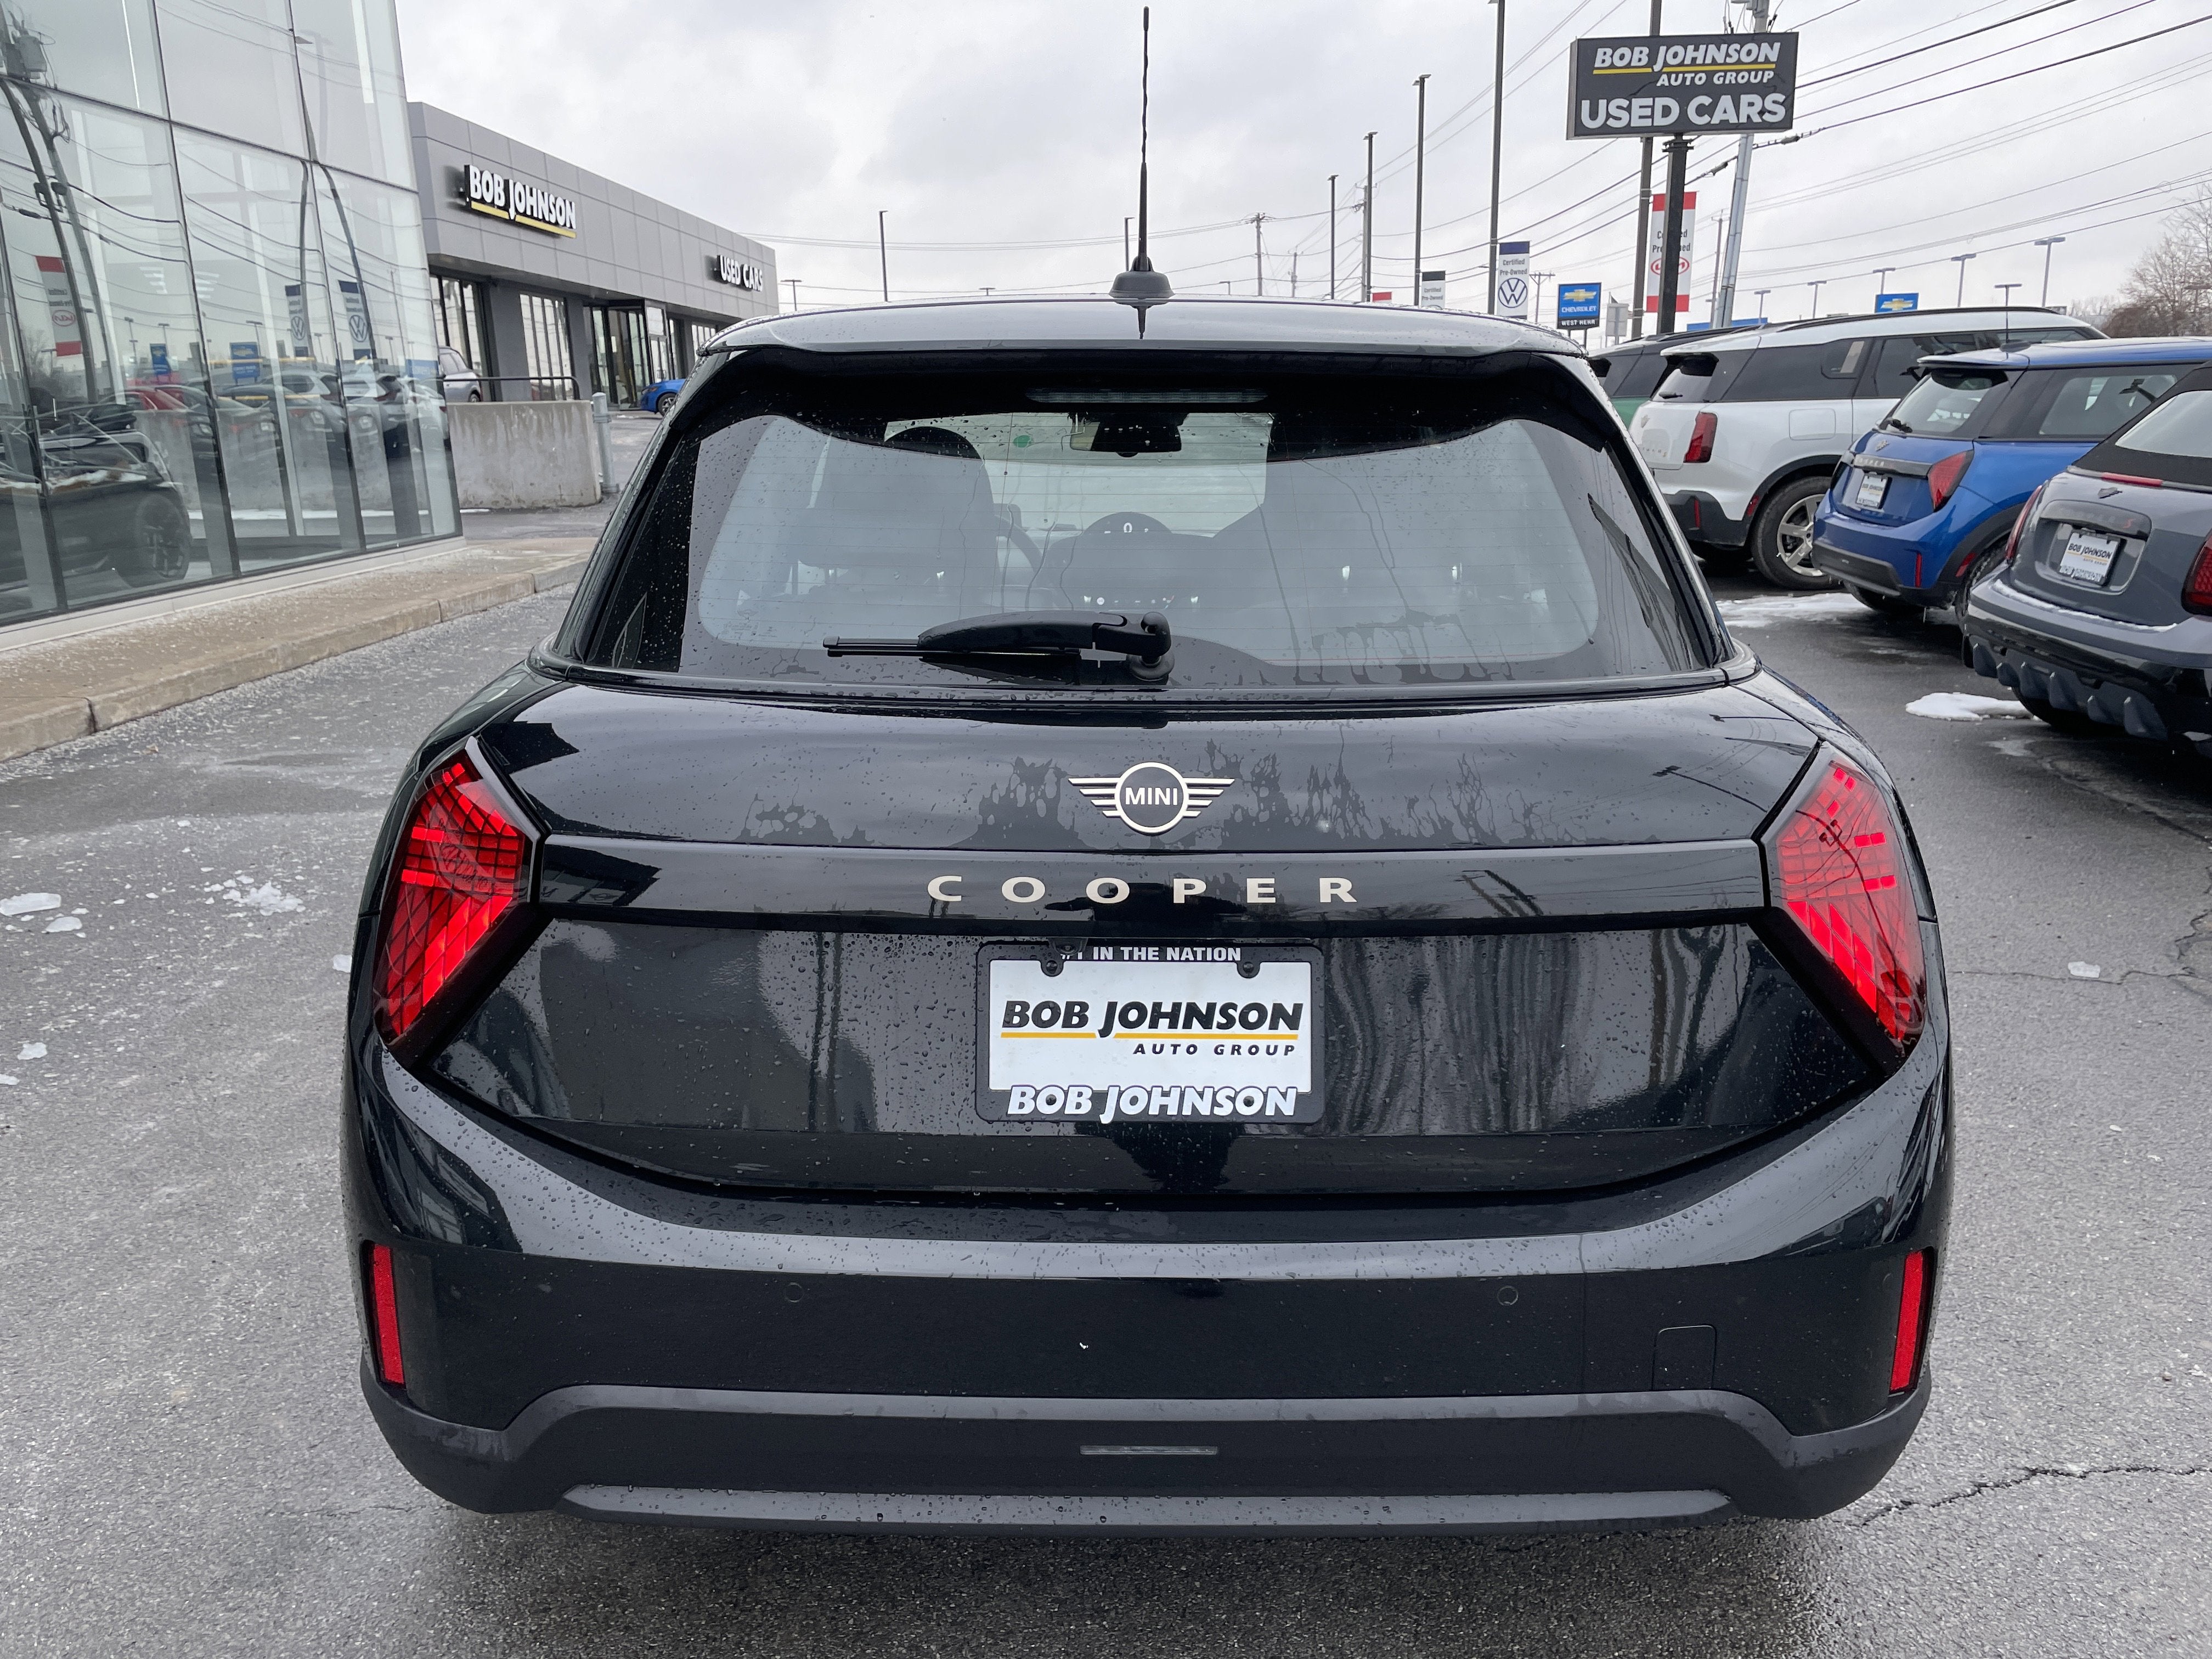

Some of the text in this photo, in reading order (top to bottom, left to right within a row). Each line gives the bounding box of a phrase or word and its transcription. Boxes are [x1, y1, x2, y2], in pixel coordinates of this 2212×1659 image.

[1594, 42, 1781, 72] BOB JOHNSON
[1656, 70, 1775, 87] AUTO GROUP
[1581, 92, 1786, 129] USED CARS
[469, 165, 577, 229] BOB JOHNSON
[720, 255, 763, 292] USED CARS
[2068, 543, 2113, 560] BOB JOHNSON
[1125, 787, 1179, 806] MINI
[927, 875, 1358, 904] COOPER
[1093, 947, 1114, 960] IN
[1120, 947, 1159, 960] THE
[1166, 947, 1241, 961] NATION
[1002, 1000, 1304, 1039] BOB JOHNSON
[1133, 1043, 1296, 1057] AUTO GROUP
[1007, 1085, 1298, 1125] BOB JOHNSON
